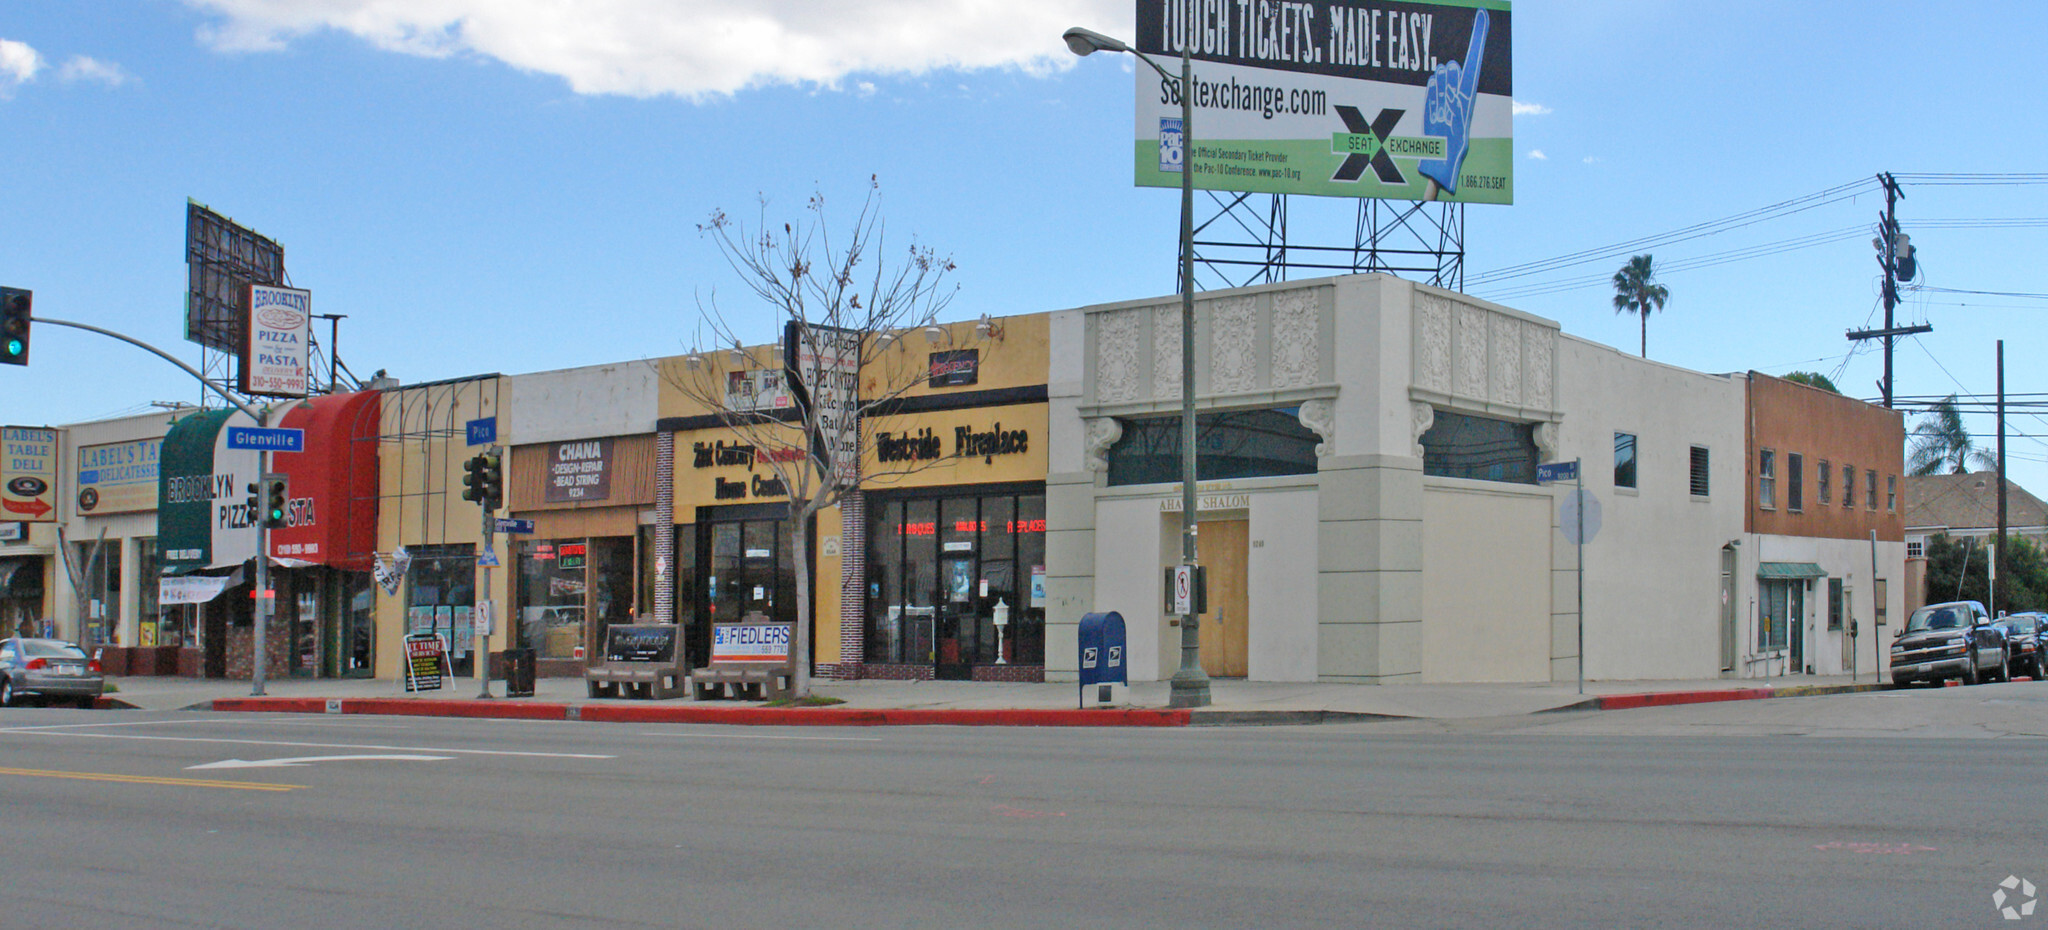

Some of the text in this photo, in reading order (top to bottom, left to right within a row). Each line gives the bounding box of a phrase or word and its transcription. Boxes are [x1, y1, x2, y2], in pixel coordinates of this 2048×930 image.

[1237, 0, 1321, 64] TICKETS.
[1329, 5, 1382, 67] MADE
[1388, 11, 1438, 72] EASY.
[1160, 74, 1326, 120] setexchange.com
[1349, 137, 1440, 155] SEAT EXCHANGE
[1198, 147, 1218, 159] Official
[1218, 148, 1247, 162] Secondary
[1248, 149, 1265, 161] Ticket
[1265, 151, 1288, 163] Provider
[1204, 163, 1223, 175] Pac-10
[1258, 167, 1301, 181] www.pac-10.org
[1461, 175, 1506, 190] 1.866.276.SEAT
[254, 289, 307, 313] BROOKLYN
[259, 331, 298, 344] PIZZA
[259, 354, 298, 366] PASTA
[252, 376, 305, 390] 310-550-9993
[3, 430, 54, 443] LABEL'S
[235, 431, 295, 446] Glenville
[473, 426, 490, 438] Pico
[8, 444, 49, 456] TABLE
[559, 441, 602, 461] CHANA
[876, 422, 1029, 465] Westside Fireplace
[12, 458, 44, 471] DELI
[81, 445, 135, 469] LABEL'S
[715, 440, 756, 472] Century
[167, 473, 234, 503] BROOKLYN
[576, 474, 600, 486] STRING
[715, 477, 746, 499] Home
[1203, 495, 1250, 509] SHALOM
[729, 627, 790, 645] FIEDLERS
